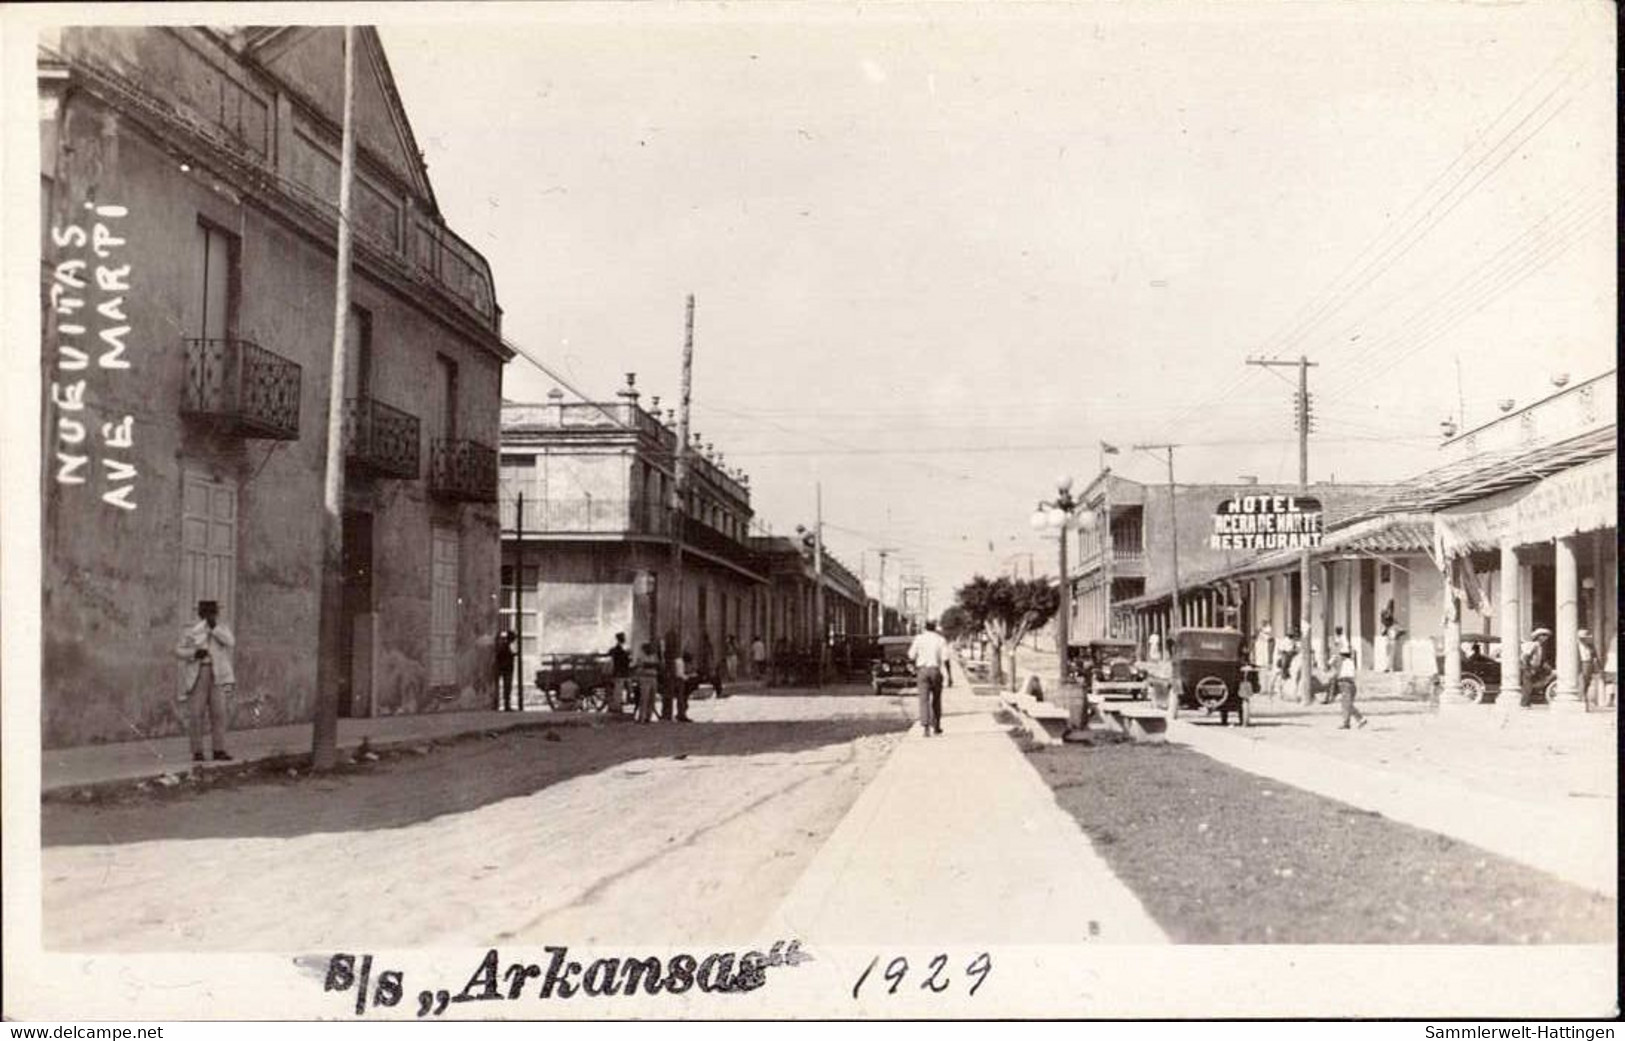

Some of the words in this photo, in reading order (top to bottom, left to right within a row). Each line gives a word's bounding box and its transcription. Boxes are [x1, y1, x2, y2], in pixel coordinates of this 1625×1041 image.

[50, 225, 90, 484] NUEVITAS
[101, 415, 138, 509] AVE
[1228, 495, 1300, 513] HOTEL
[1210, 532, 1322, 549] RESTAURANT
[853, 951, 992, 999] 1929
